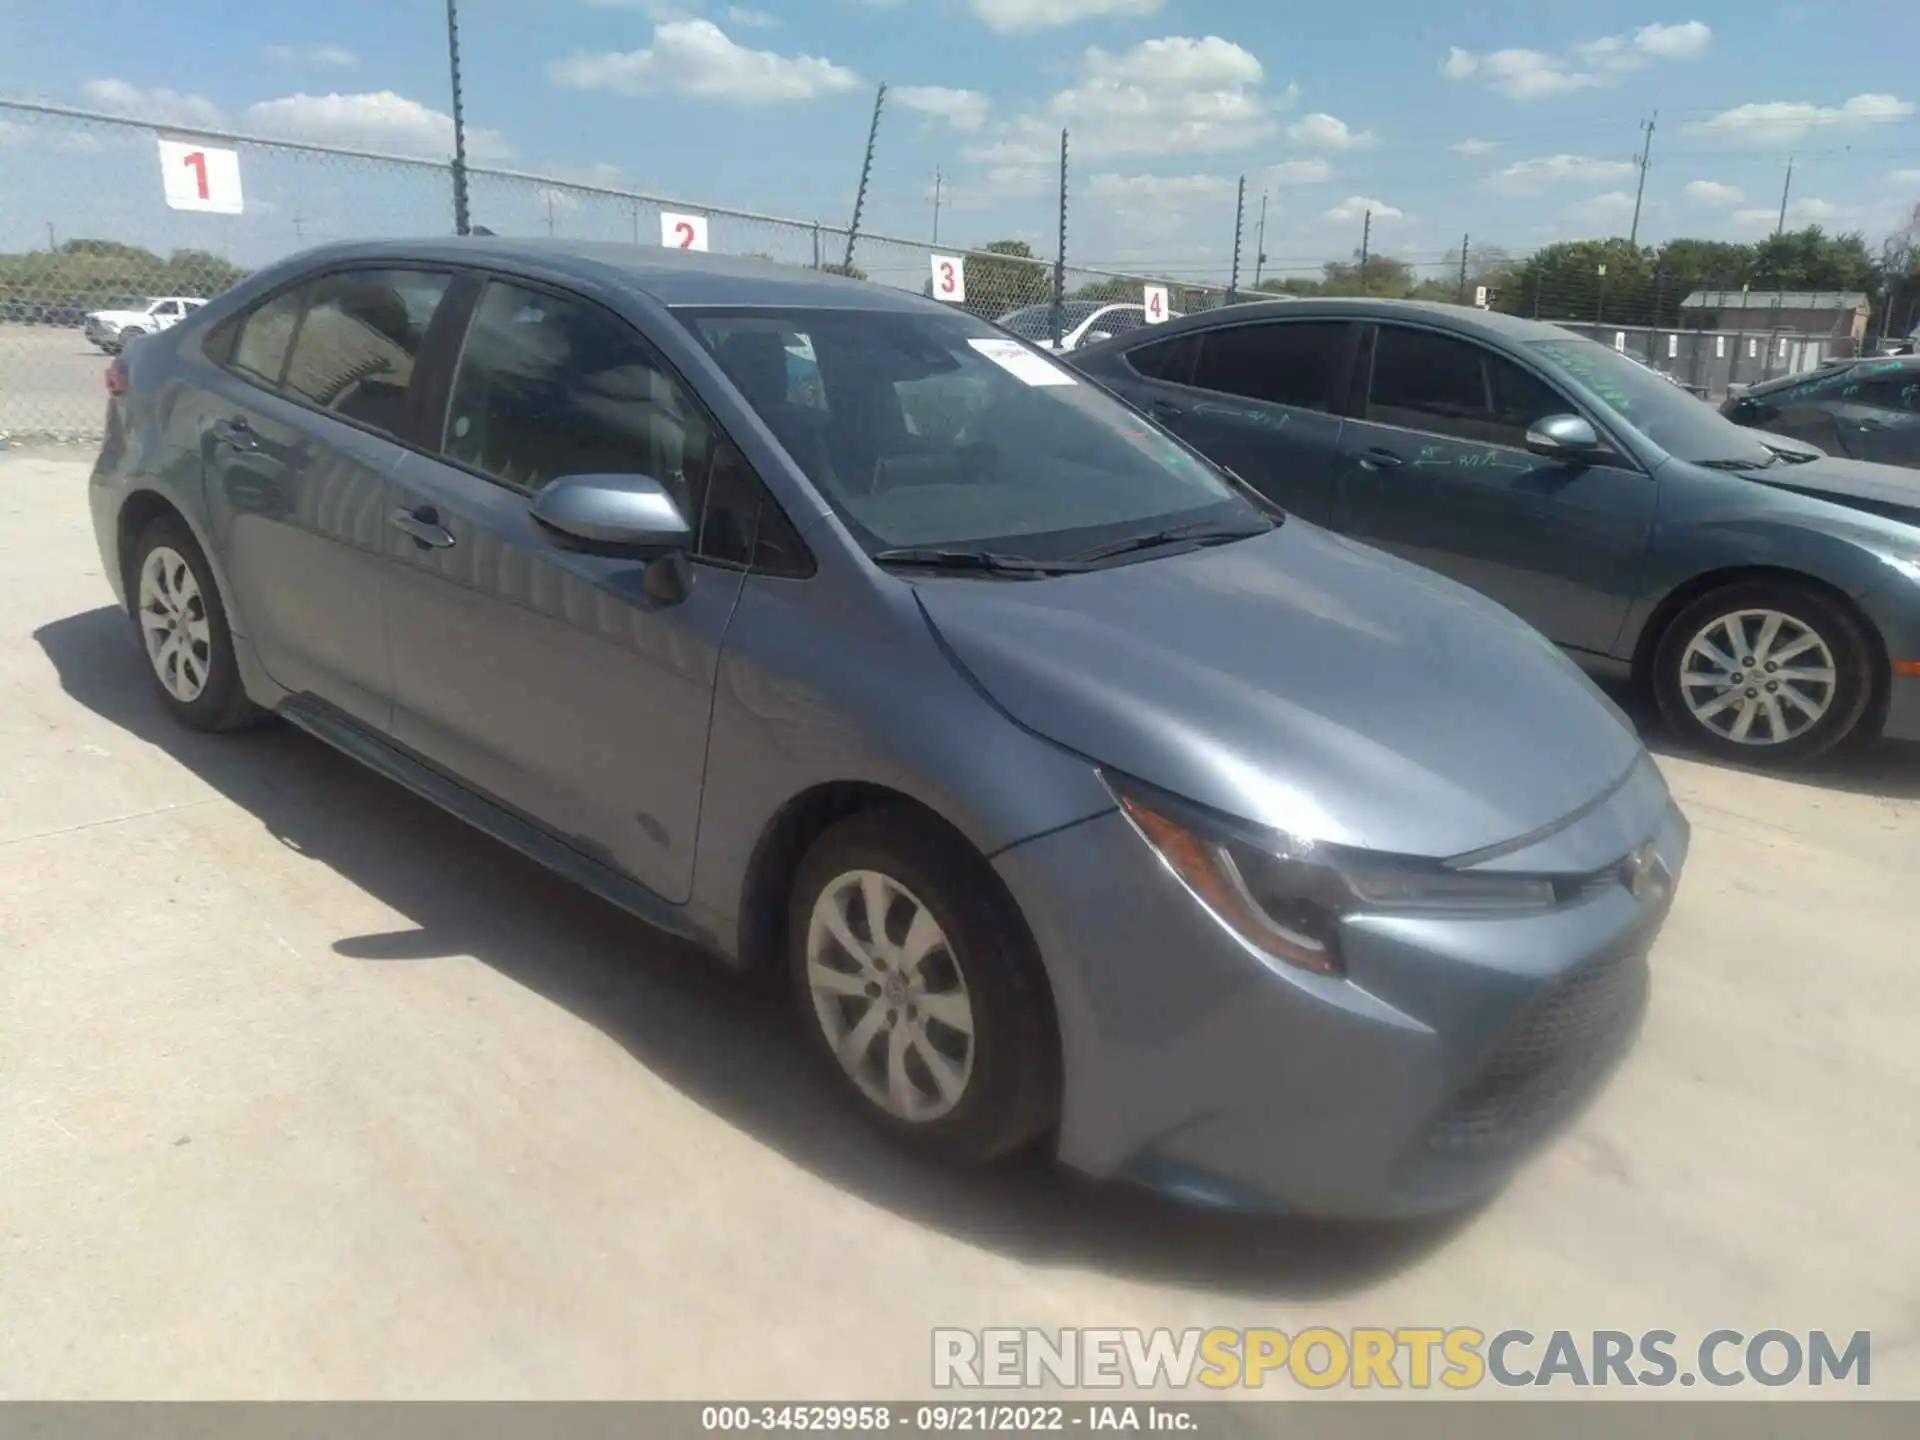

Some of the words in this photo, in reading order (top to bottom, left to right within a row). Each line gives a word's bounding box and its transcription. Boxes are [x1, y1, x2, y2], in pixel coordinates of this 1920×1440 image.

[183, 151, 210, 200] 1
[675, 222, 695, 249] 2
[940, 261, 955, 293] 3
[1150, 292, 1162, 318] 4
